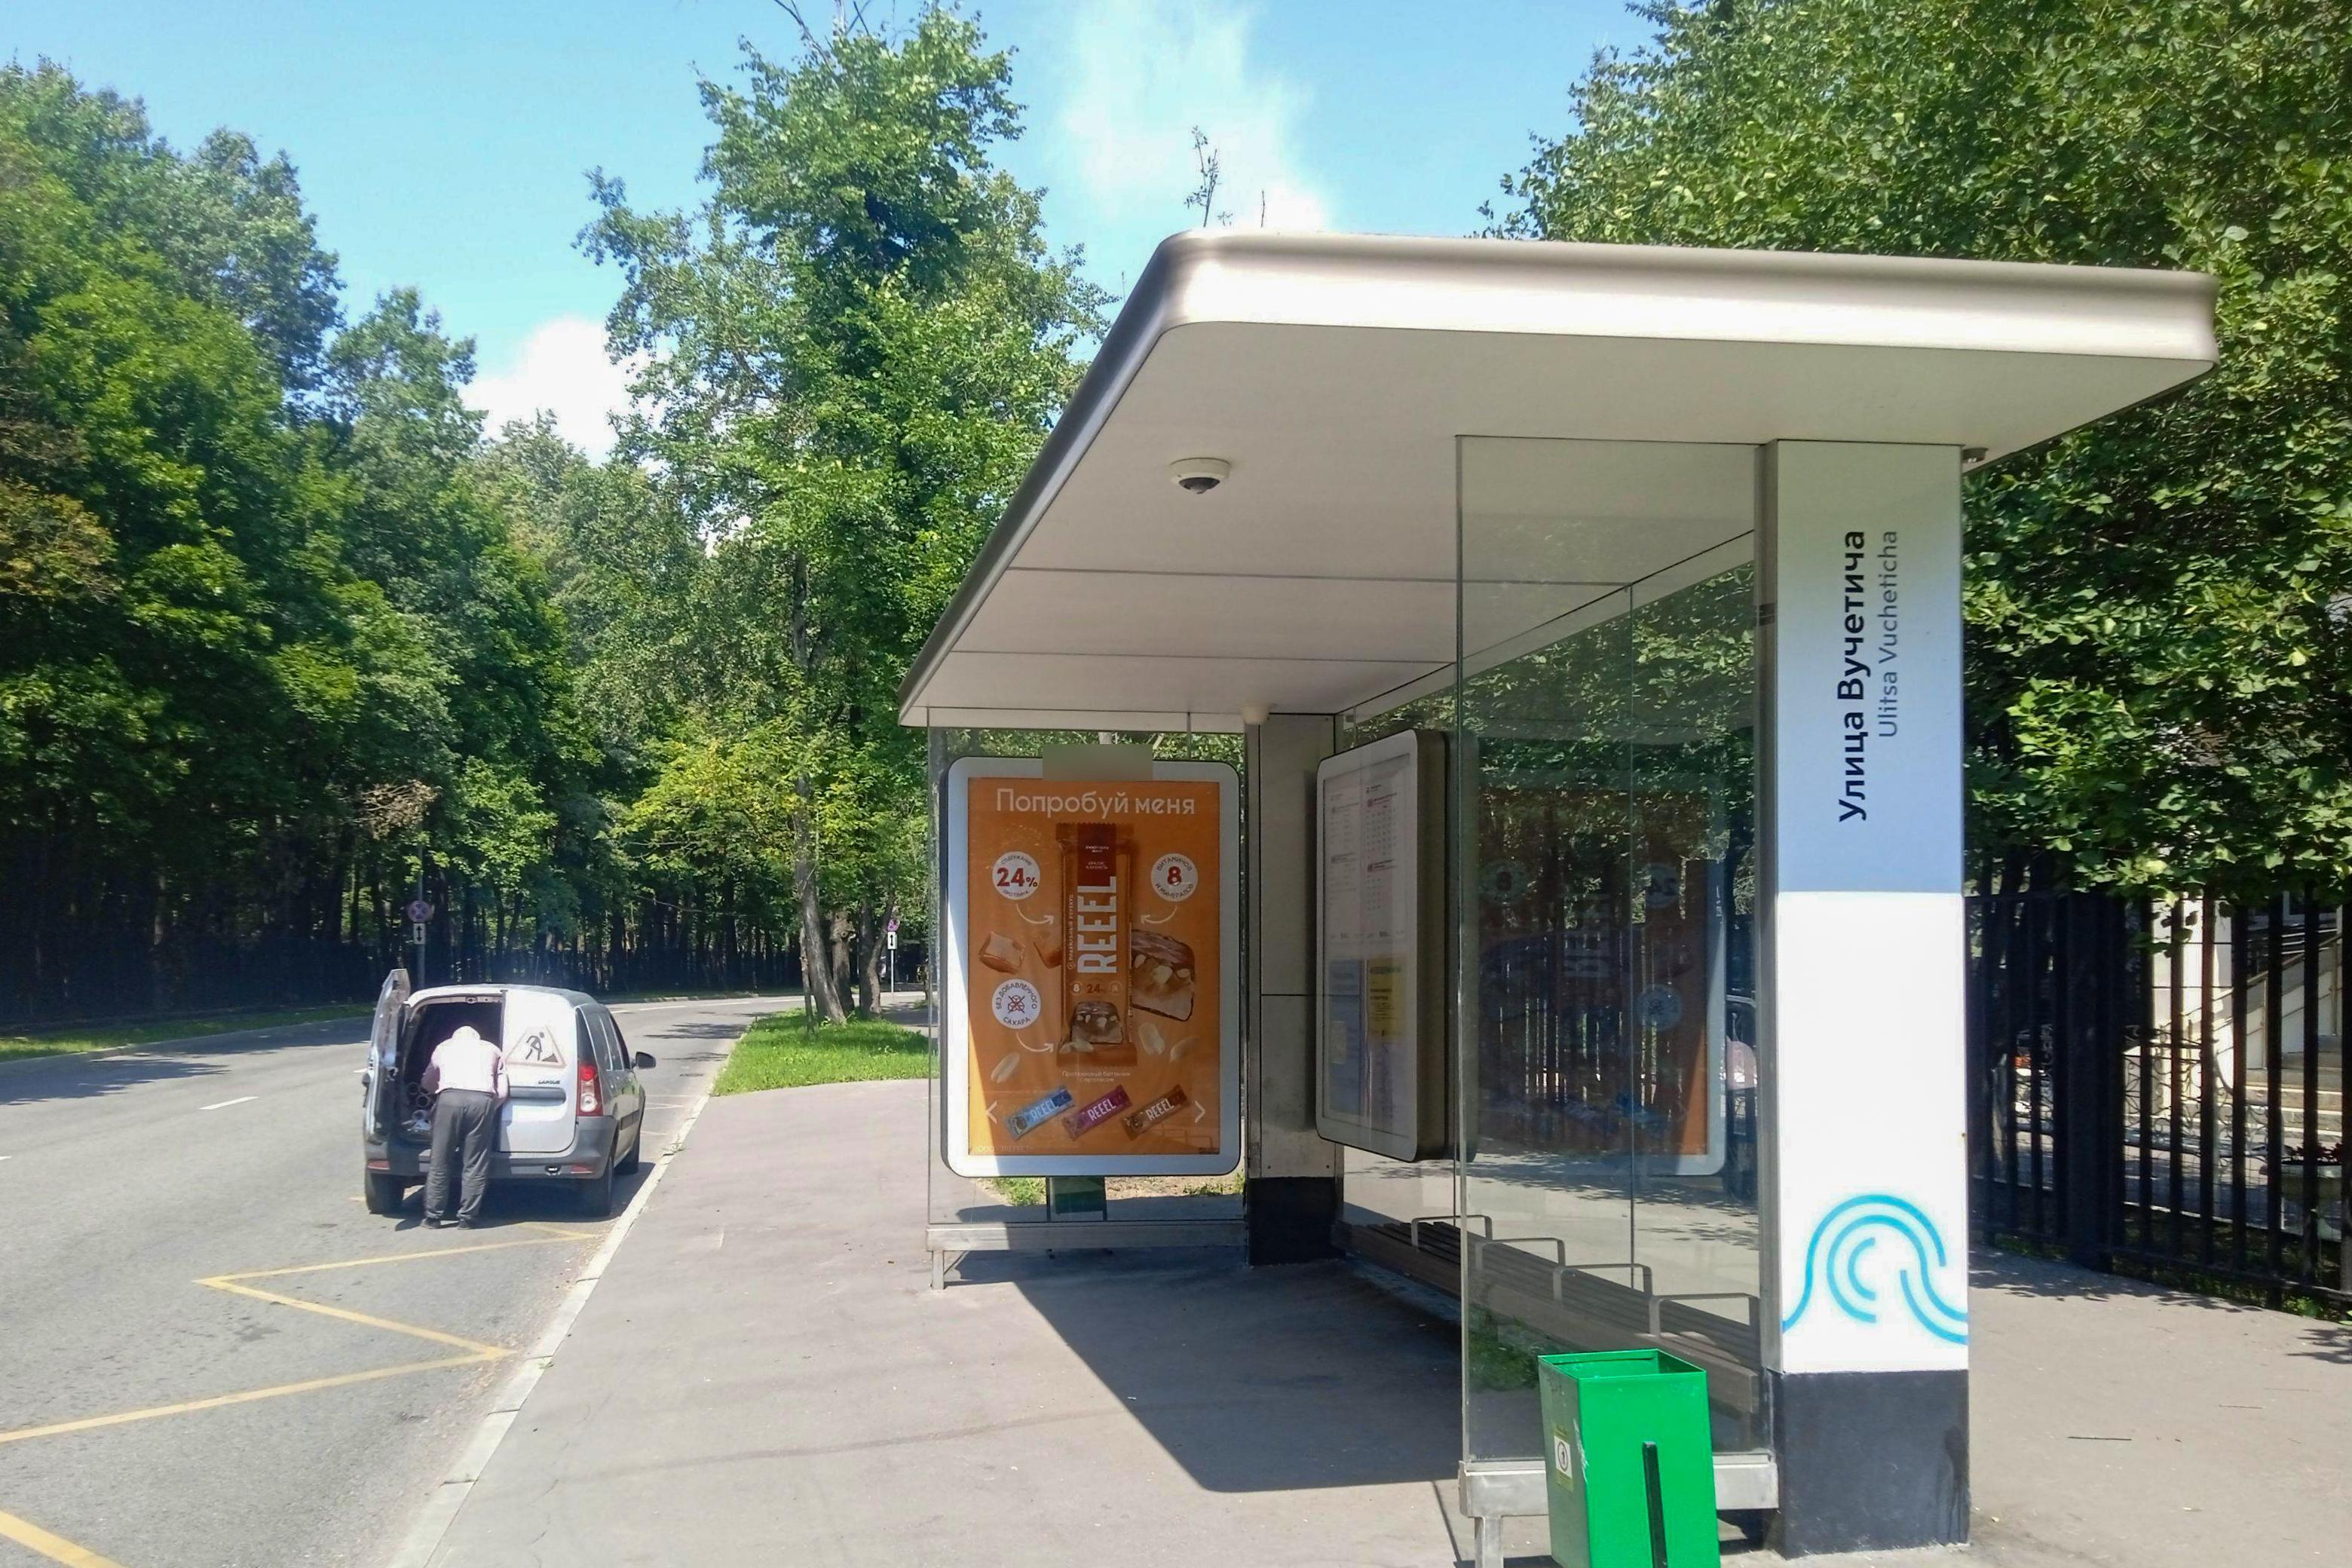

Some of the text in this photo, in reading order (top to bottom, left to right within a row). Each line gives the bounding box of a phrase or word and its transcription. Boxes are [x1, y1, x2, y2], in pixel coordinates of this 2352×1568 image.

[1876, 530, 1898, 737] Ulitsa Vucheticha
[1836, 530, 1871, 822] Улица Вучетича
[997, 788, 1196, 819] Попробуй меня
[997, 867, 1038, 887] 24%
[1167, 865, 1182, 887] 8
[1077, 876, 1117, 973] REEEL
[998, 982, 1038, 1009] ДОБАВЛЕННОГО
[1003, 1016, 1031, 1026] САХАРА
[1031, 1098, 1061, 1121] REEEL
[1087, 1098, 1117, 1122] REEEL
[1146, 1098, 1175, 1122] REEEL
